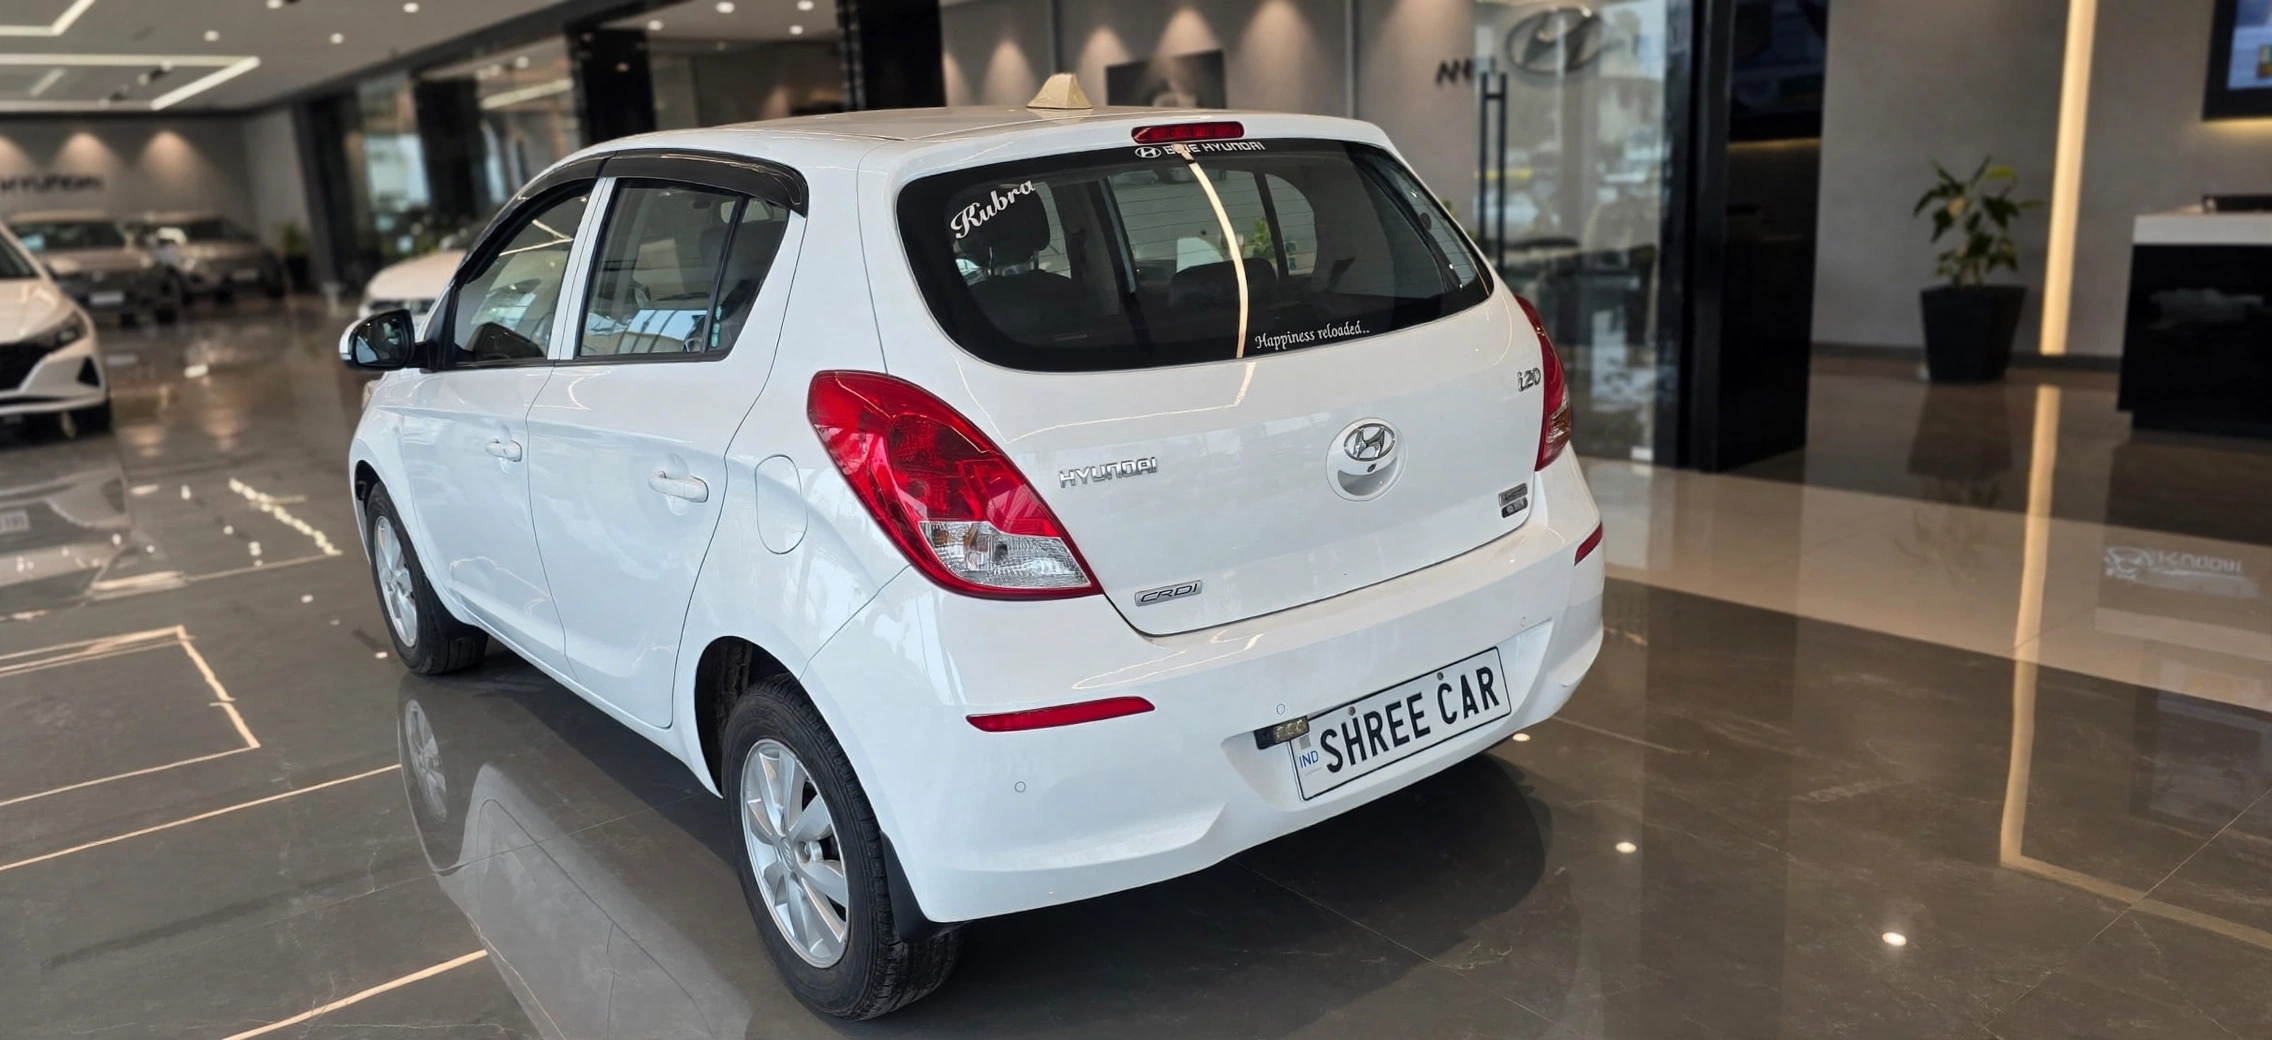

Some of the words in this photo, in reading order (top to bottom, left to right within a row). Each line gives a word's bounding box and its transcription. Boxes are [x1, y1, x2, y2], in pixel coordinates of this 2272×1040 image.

[1201, 141, 1266, 152] HYUNDAI
[1255, 331, 1316, 351] Happiness
[1517, 367, 1542, 393] i20
[1059, 456, 1157, 488] HYUNDAI
[1319, 692, 1431, 773] SHREE
[1436, 666, 1500, 725] CAR
[1299, 750, 1319, 769] IND
